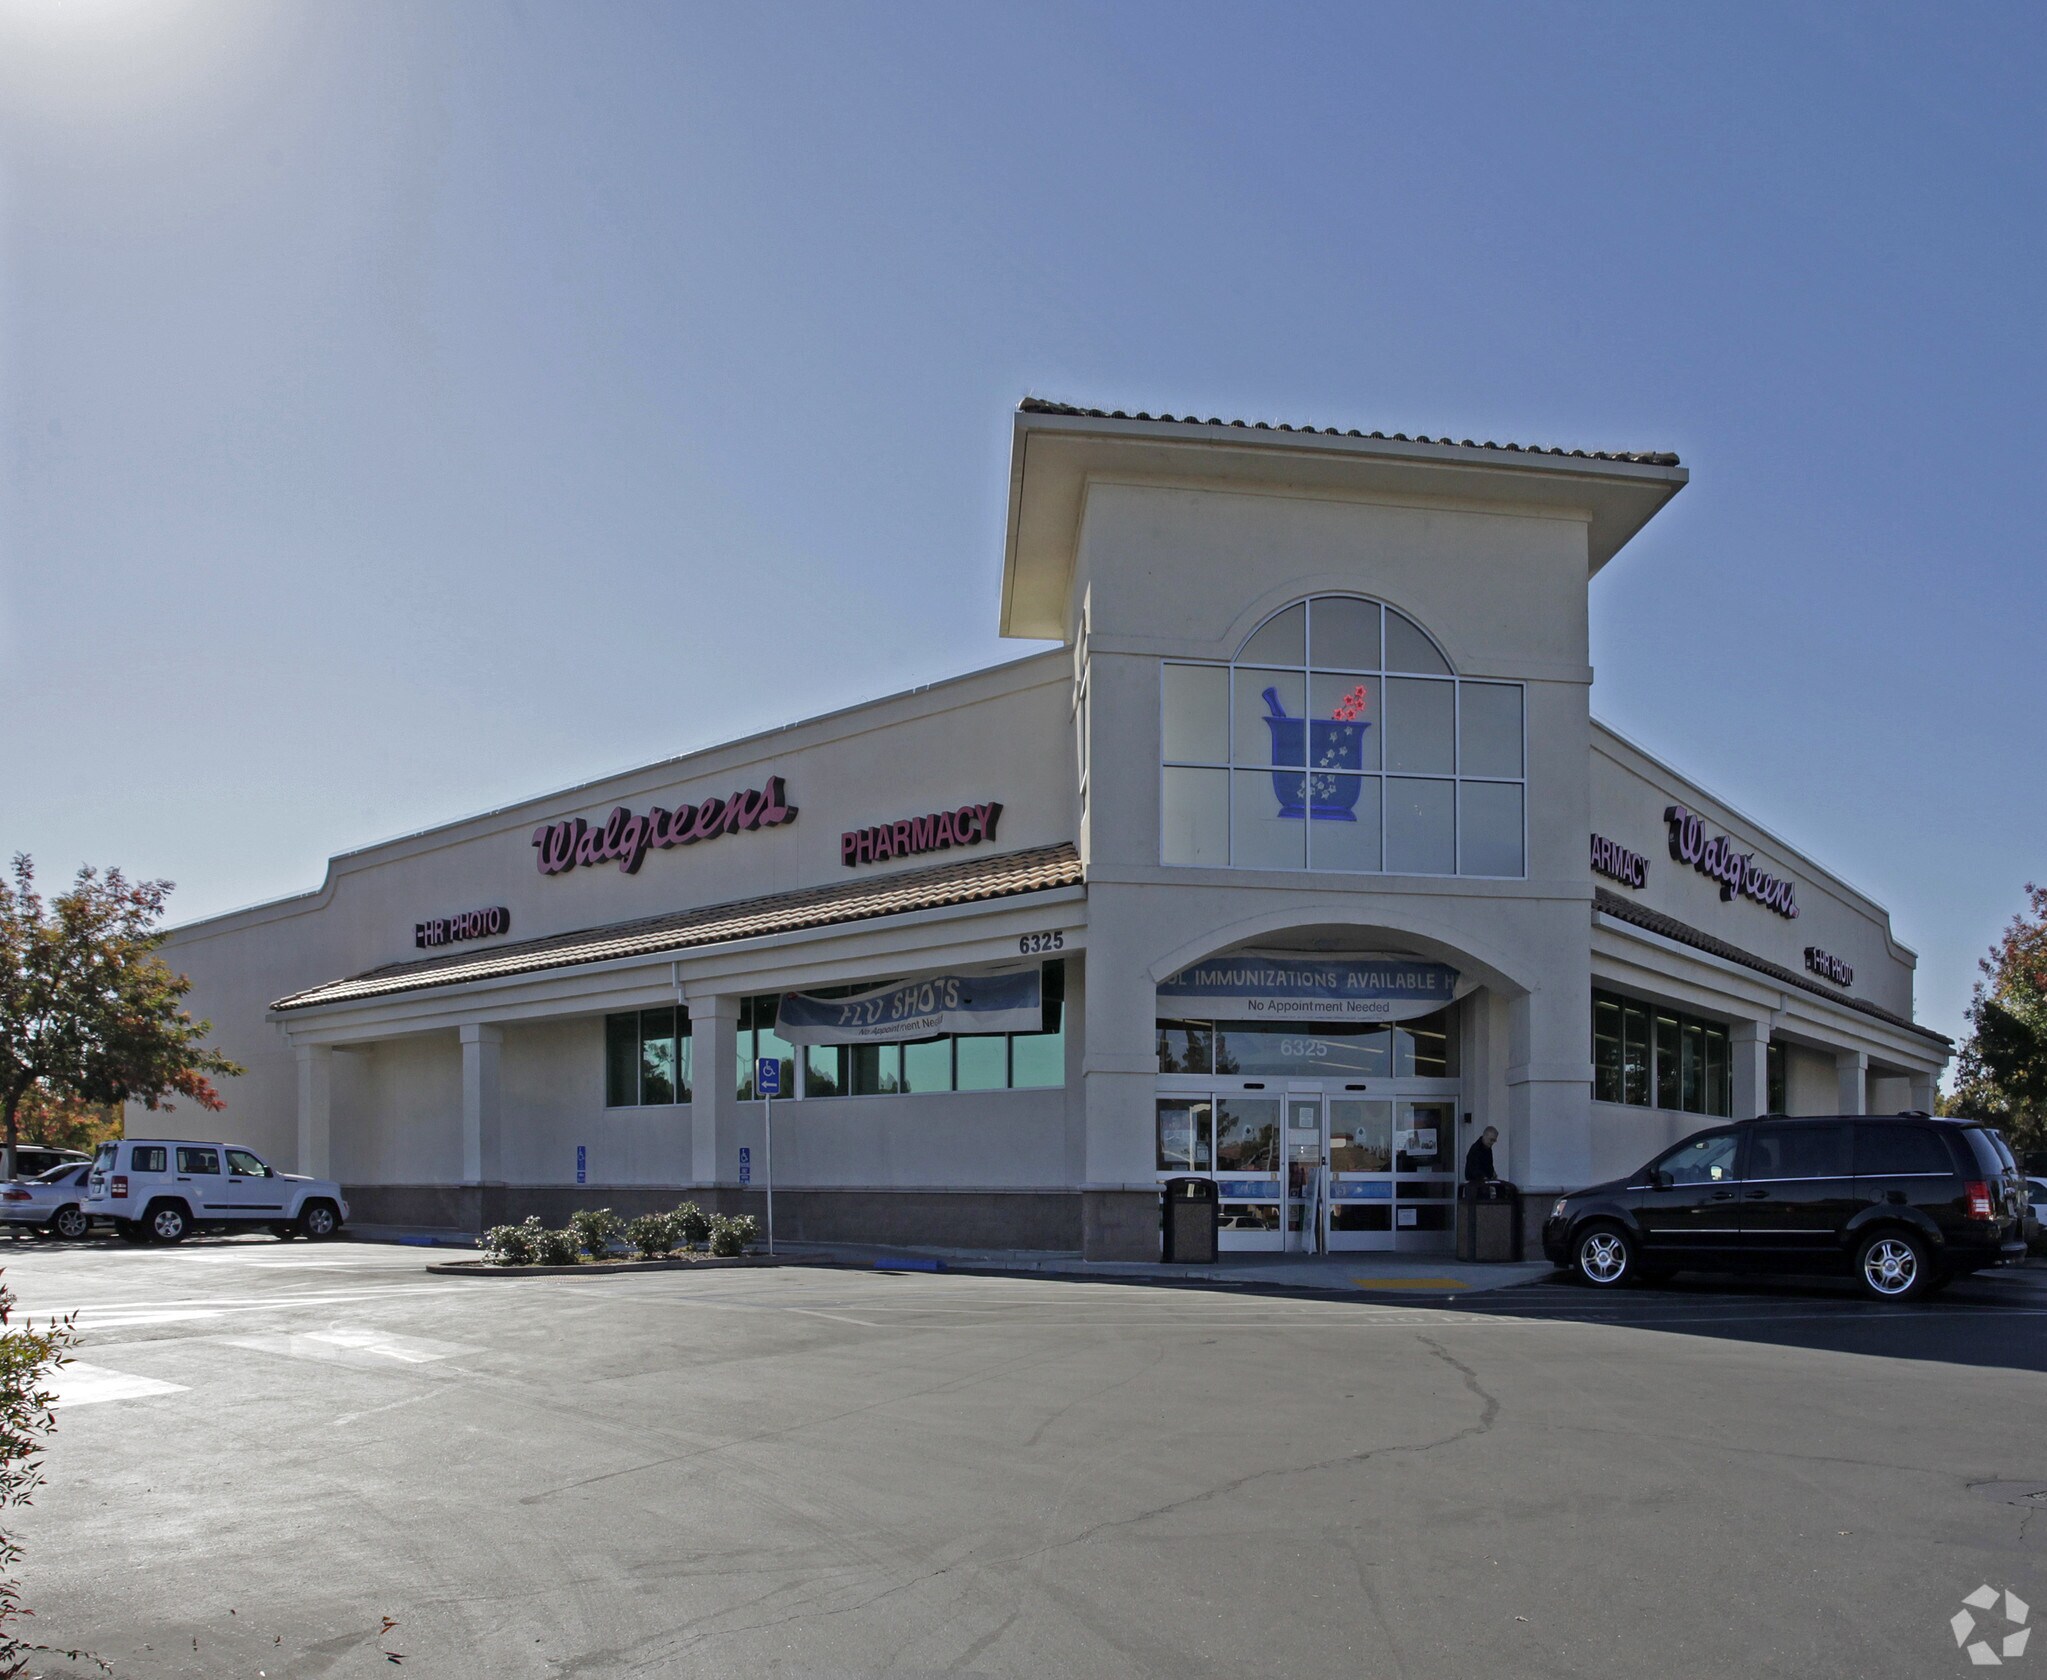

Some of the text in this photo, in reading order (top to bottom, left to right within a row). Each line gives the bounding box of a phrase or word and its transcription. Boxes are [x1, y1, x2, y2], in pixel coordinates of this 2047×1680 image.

[532, 776, 798, 875] Walgreens
[841, 802, 1003, 867] PHARMACY
[1591, 833, 1650, 889] ARMACY
[1664, 805, 1799, 919] Walgreens
[449, 906, 509, 941] PHOTO
[1019, 931, 1064, 954] 6325
[1195, 970, 1337, 988] IMMUNIZATIONS
[1347, 972, 1436, 989] AVAILABLE
[1832, 955, 1853, 987] PHOTO
[891, 979, 960, 1019] SHOTS
[1248, 1000, 1390, 1013] No Appointment Needed
[1281, 1039, 1328, 1056] 6325
